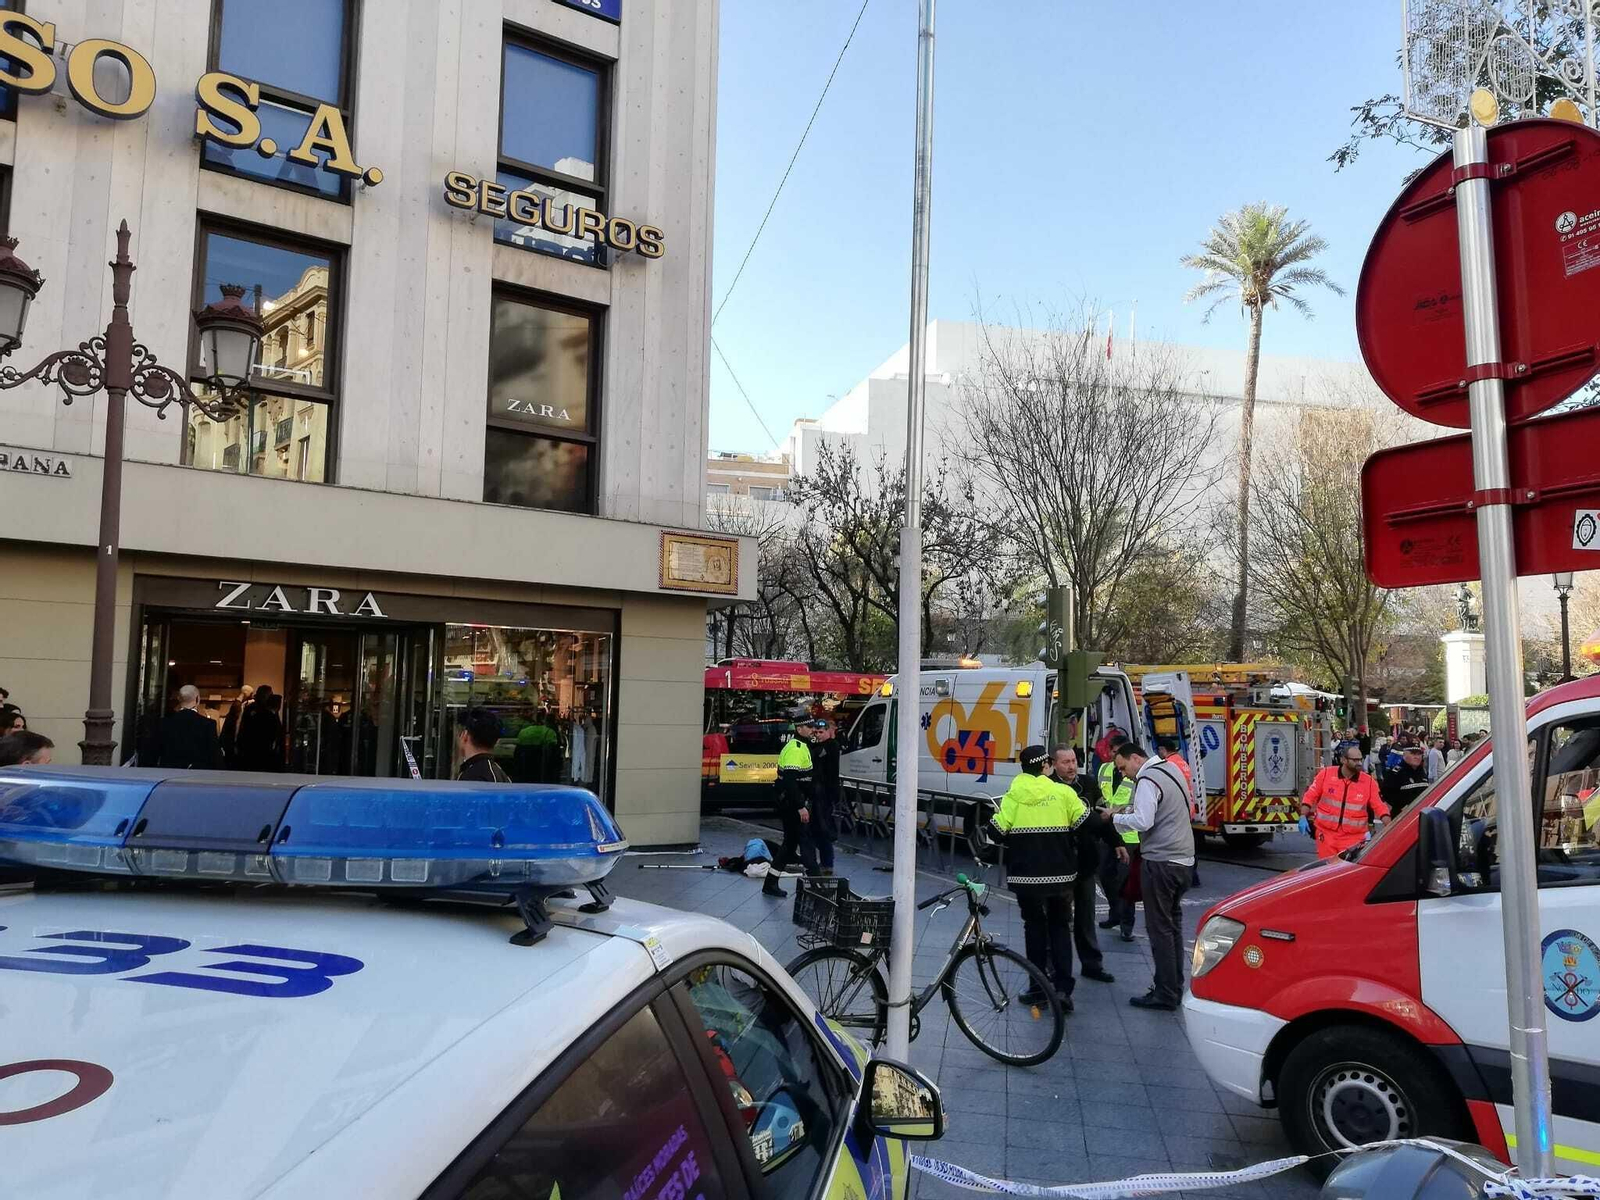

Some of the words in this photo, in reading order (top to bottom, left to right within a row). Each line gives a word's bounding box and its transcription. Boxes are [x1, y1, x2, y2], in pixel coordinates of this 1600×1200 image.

[195, 72, 384, 187] S.A.
[443, 170, 666, 259] SEGUROS
[507, 398, 572, 422] ZARA
[215, 580, 389, 618] ZARA
[724, 670, 732, 689] 1
[1239, 723, 1249, 801] BOMBEROS
